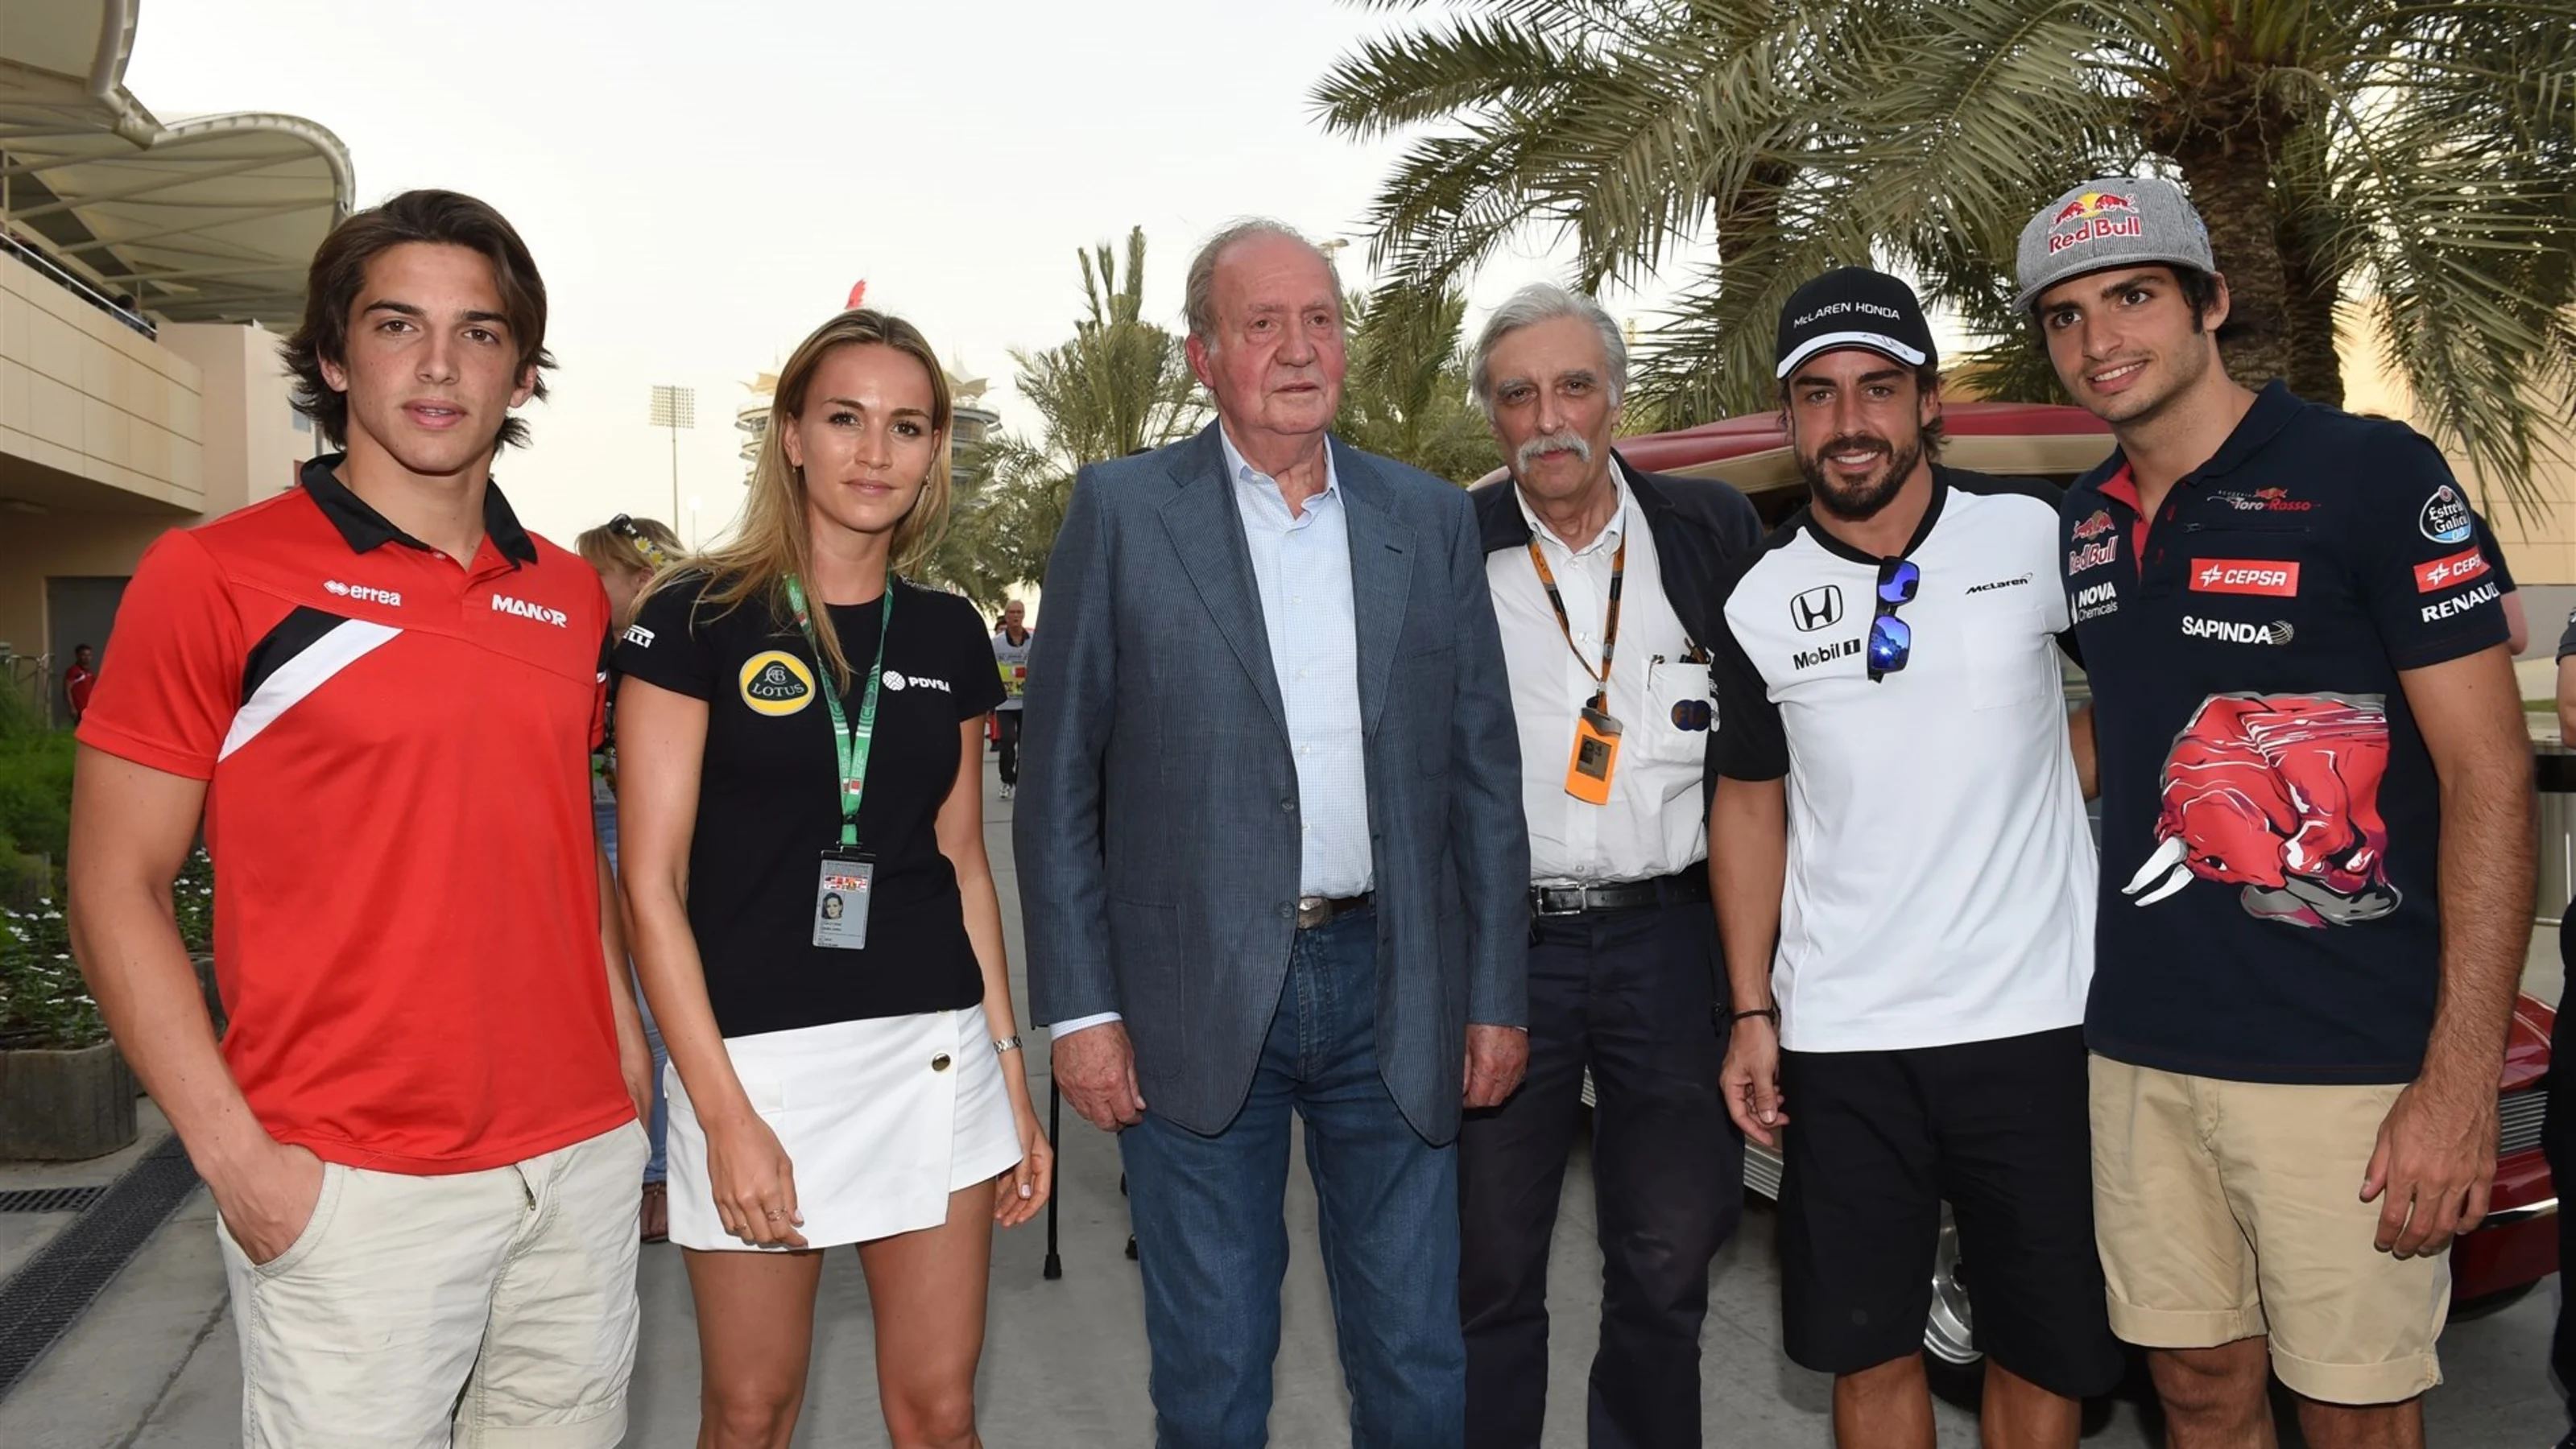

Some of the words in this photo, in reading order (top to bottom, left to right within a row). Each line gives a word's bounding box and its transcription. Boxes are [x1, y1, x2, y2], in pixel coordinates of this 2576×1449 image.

[2049, 221, 2091, 255] Red
[2094, 217, 2141, 238] Bull
[1793, 302, 1851, 328] McLAREN
[1855, 302, 1900, 320] HONDA
[2234, 497, 2264, 510] Toro
[2268, 498, 2311, 510] Rosso
[2069, 543, 2091, 576] Red
[2090, 535, 2119, 564] Bull
[1965, 577, 2028, 595] McLaren
[2224, 569, 2287, 587] CEPSA
[2078, 581, 2117, 608] NOVA
[492, 594, 567, 628] MANOR
[2078, 600, 2119, 621] Chemicals
[2181, 615, 2273, 645] SAPINDA
[1793, 643, 1840, 670] Mobil
[752, 683, 805, 697] LOTUS
